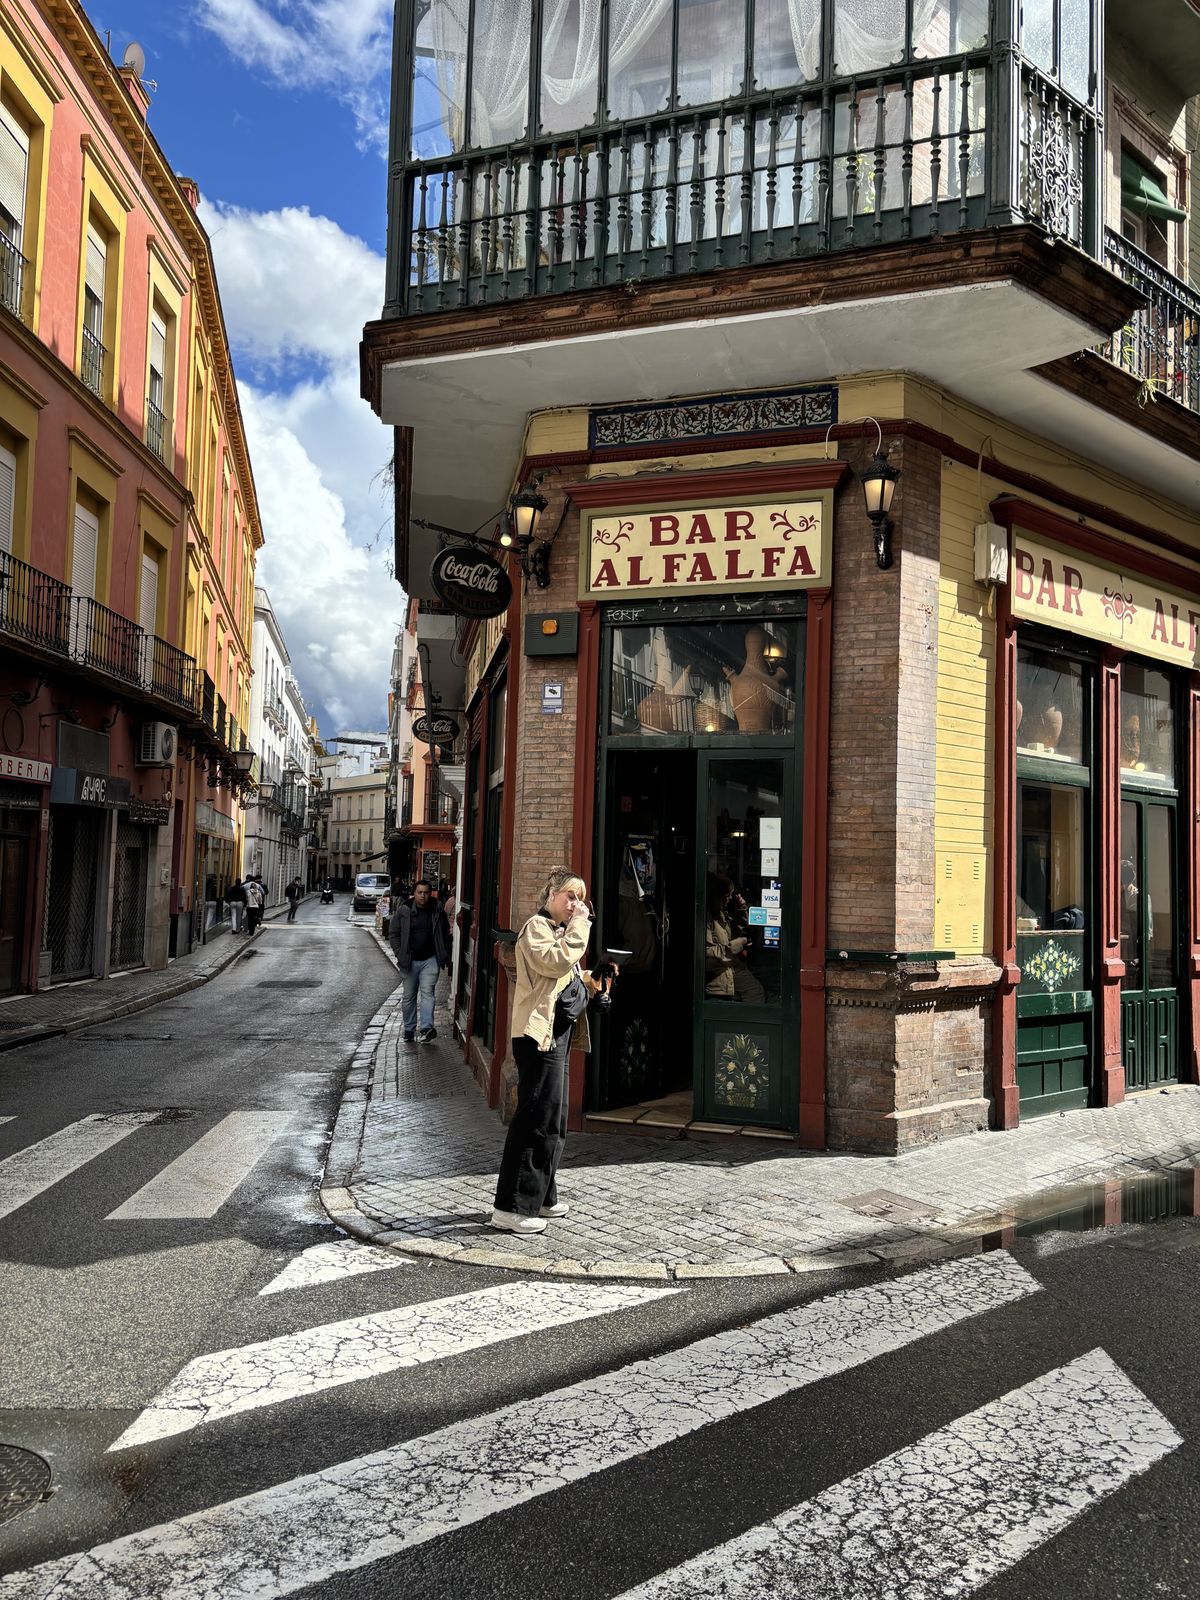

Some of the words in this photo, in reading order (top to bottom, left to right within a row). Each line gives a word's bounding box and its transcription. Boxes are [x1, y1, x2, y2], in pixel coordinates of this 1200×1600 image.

[650, 510, 756, 547] BAR
[440, 555, 500, 593] Coca-Cola
[592, 545, 816, 588] ALFALFA
[1015, 549, 1083, 617] BAR
[447, 587, 463, 603] BAR
